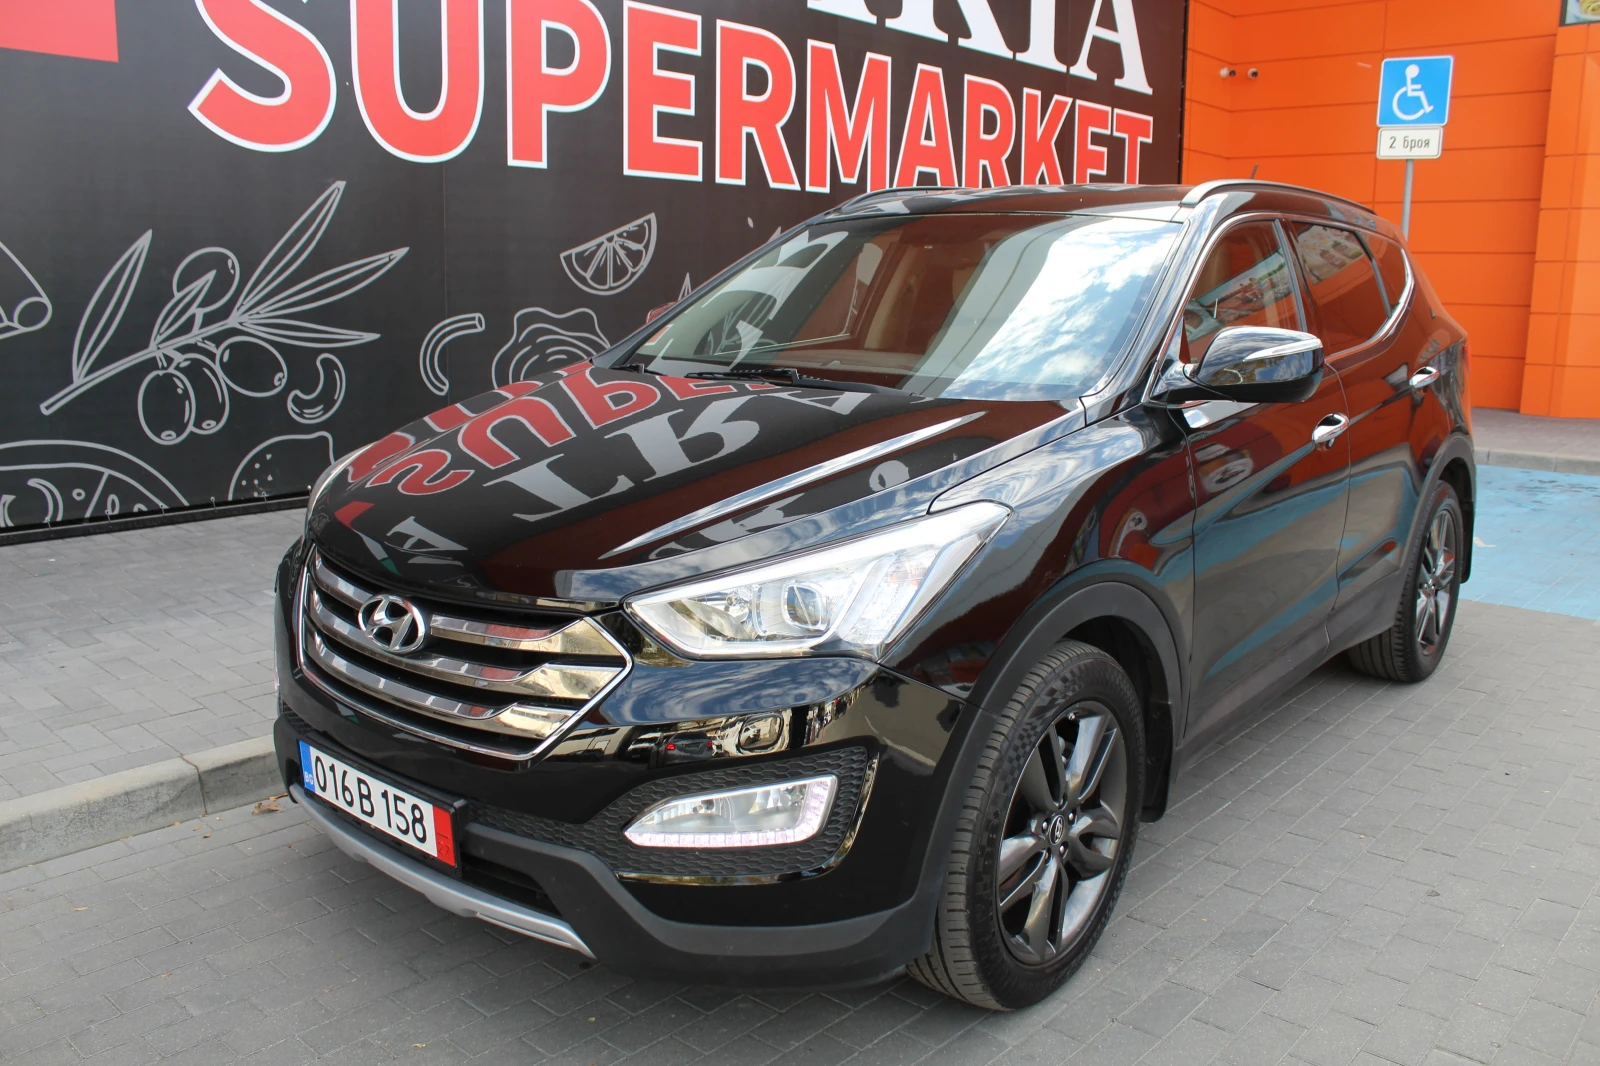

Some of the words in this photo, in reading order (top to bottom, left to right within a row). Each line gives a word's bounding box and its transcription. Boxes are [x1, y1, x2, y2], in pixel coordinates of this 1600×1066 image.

[187, 0, 1154, 193] SUPERMARKET
[1389, 136, 1397, 149] 2
[1403, 136, 1431, 152] броя
[304, 771, 314, 784] BG
